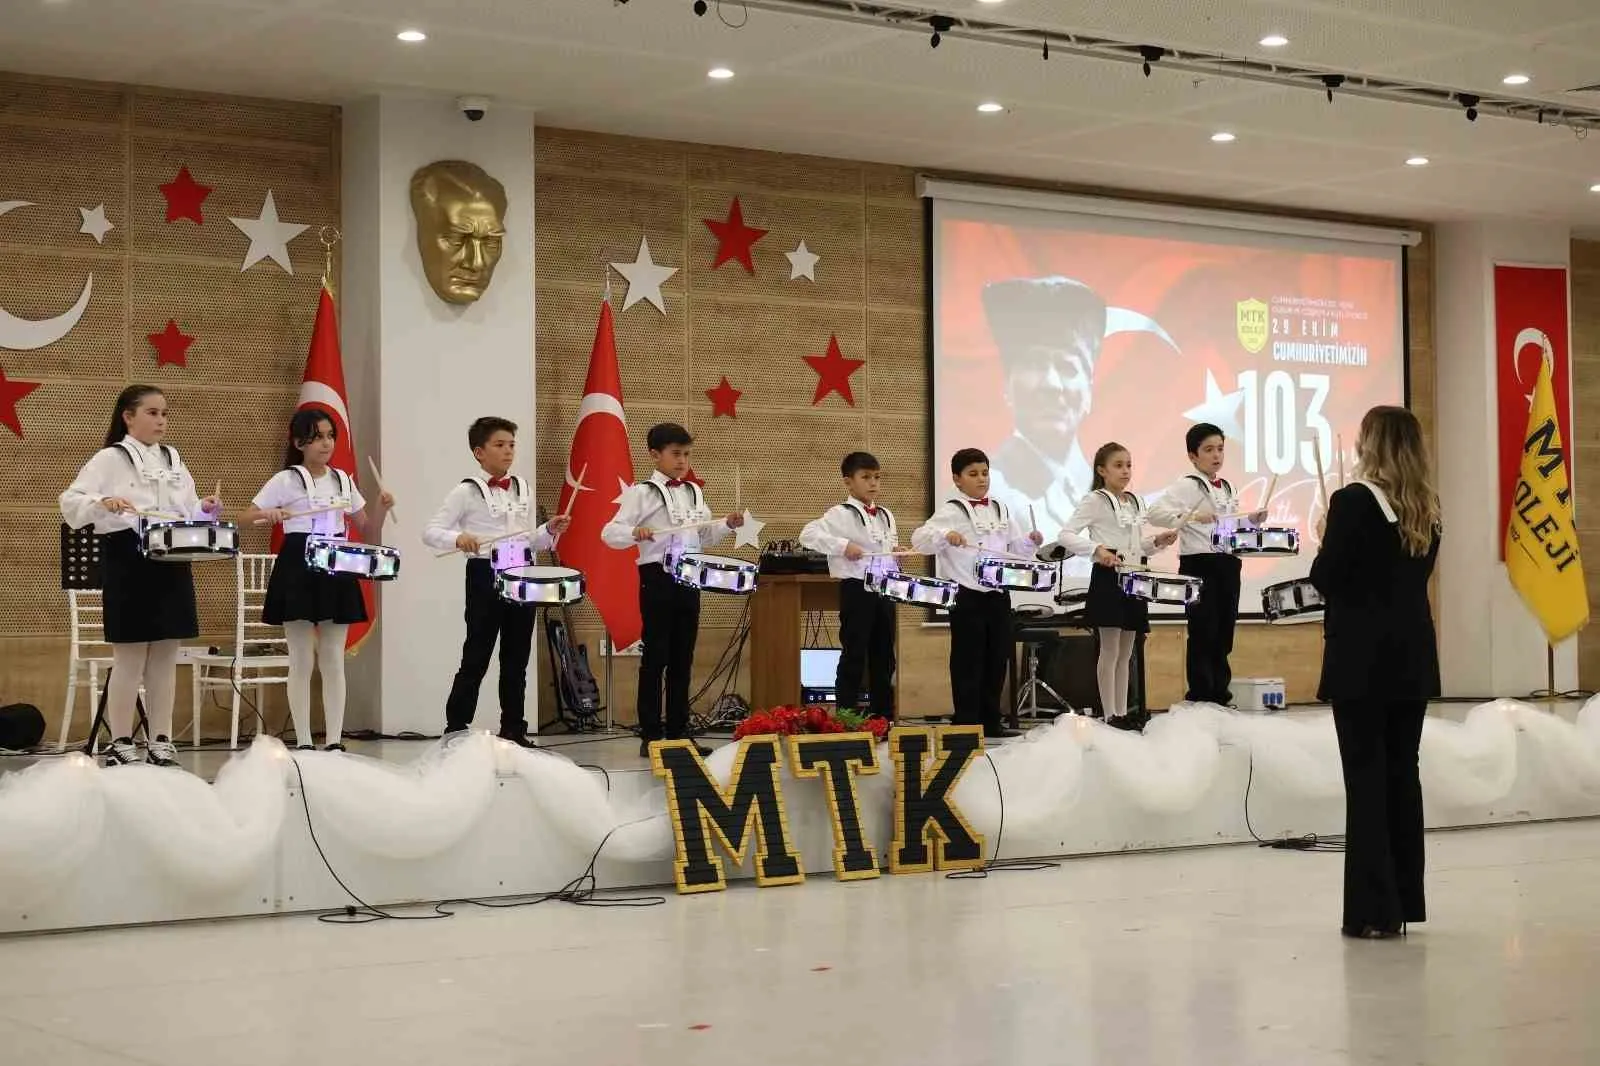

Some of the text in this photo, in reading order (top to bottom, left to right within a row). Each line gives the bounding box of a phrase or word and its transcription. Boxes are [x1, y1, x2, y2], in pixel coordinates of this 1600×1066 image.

[1240, 309, 1265, 323] MTK
[1272, 317, 1289, 335] 29
[1302, 319, 1339, 338] EKİM
[1238, 369, 1332, 476] 103
[1514, 480, 1579, 573] OLEJİ
[649, 724, 985, 895] MTK
